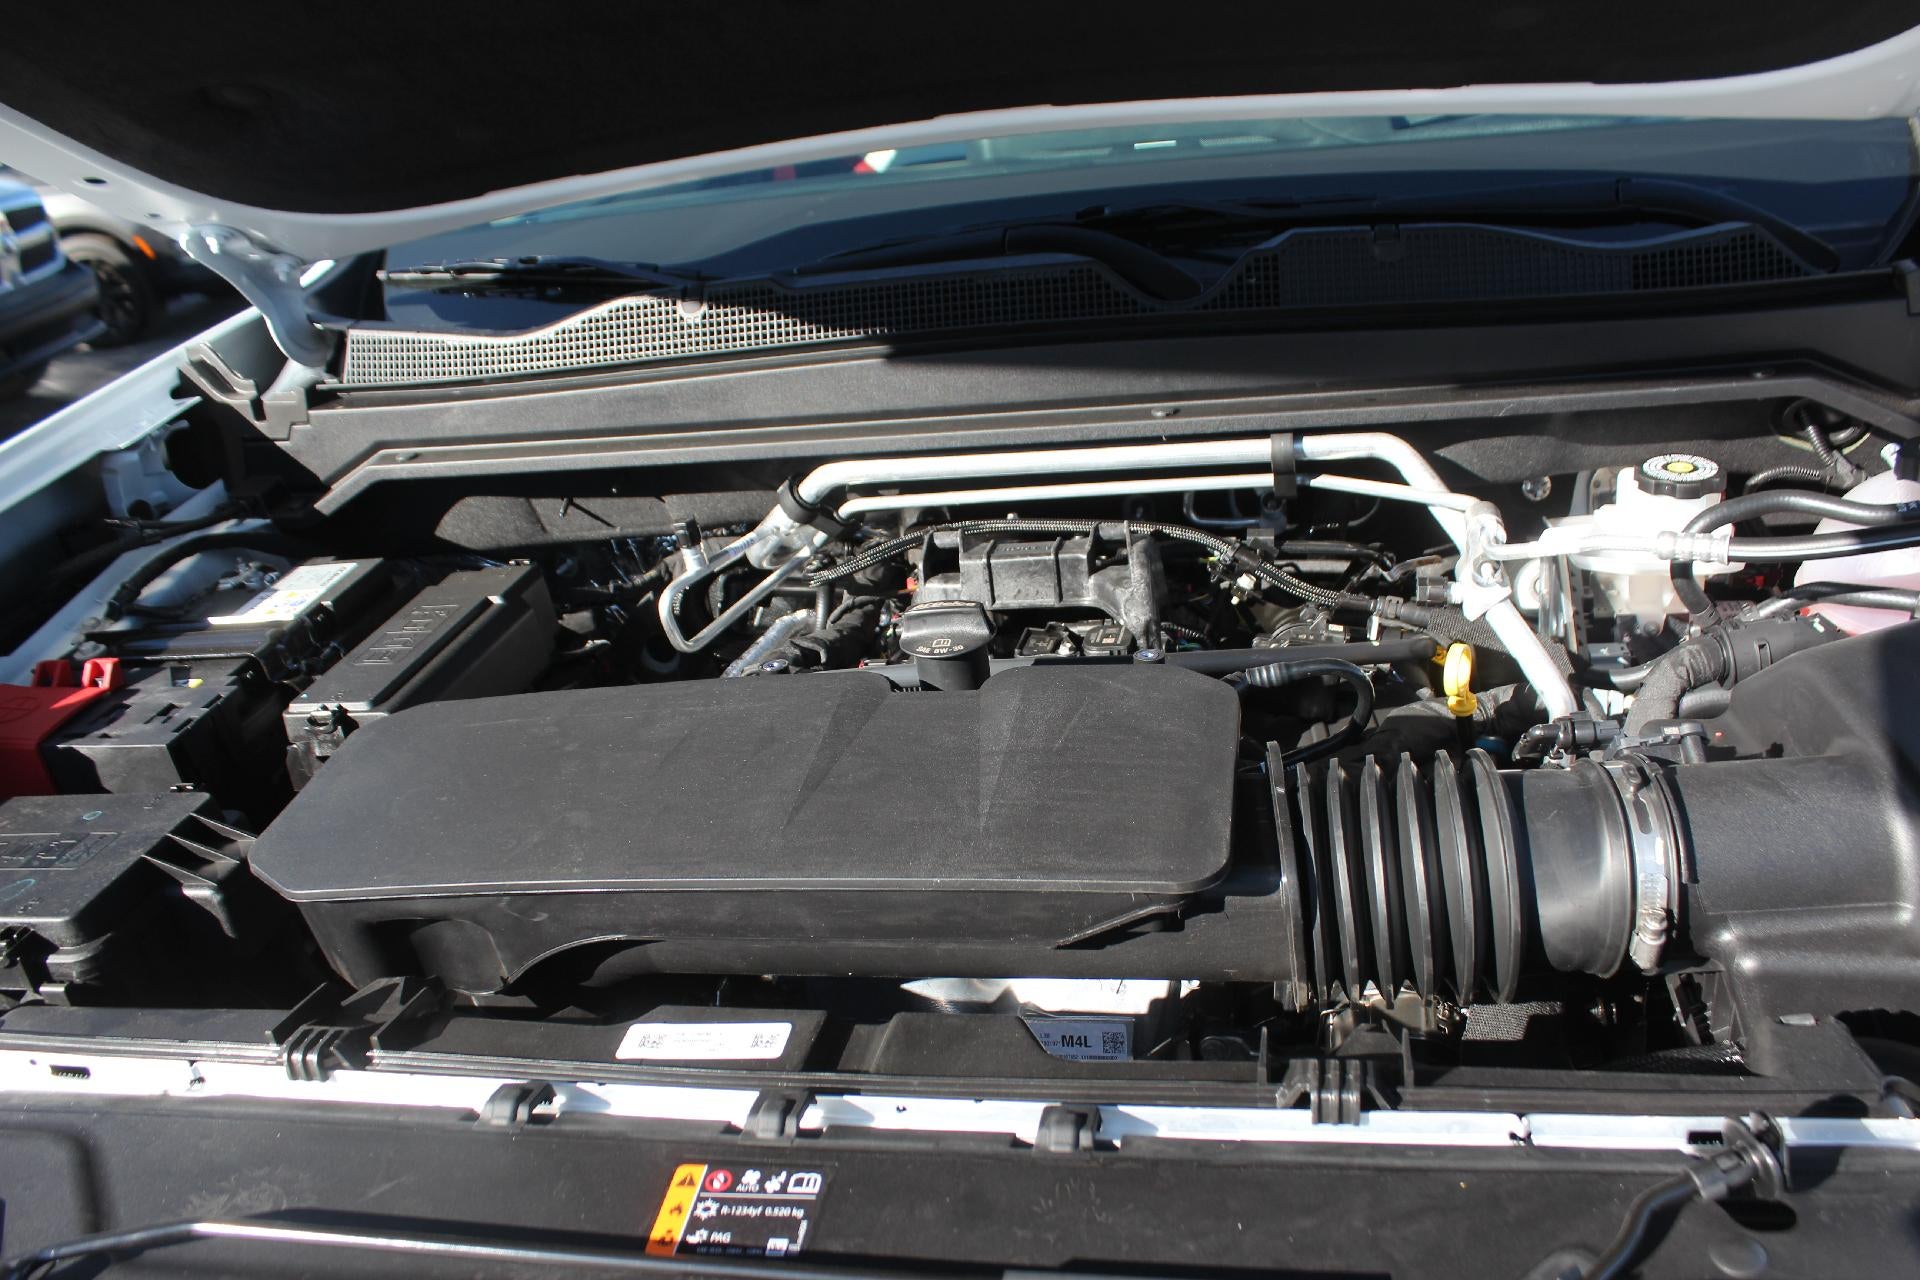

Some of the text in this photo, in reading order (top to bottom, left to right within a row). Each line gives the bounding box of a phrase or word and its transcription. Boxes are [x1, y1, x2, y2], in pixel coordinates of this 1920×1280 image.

[916, 646, 931, 654] SAE
[1061, 1034, 1092, 1048] M4L
[735, 1184, 759, 1192] AUTO
[721, 1205, 763, 1217] R-1234yf
[792, 1206, 804, 1219] kg
[710, 1232, 731, 1243] PAG
